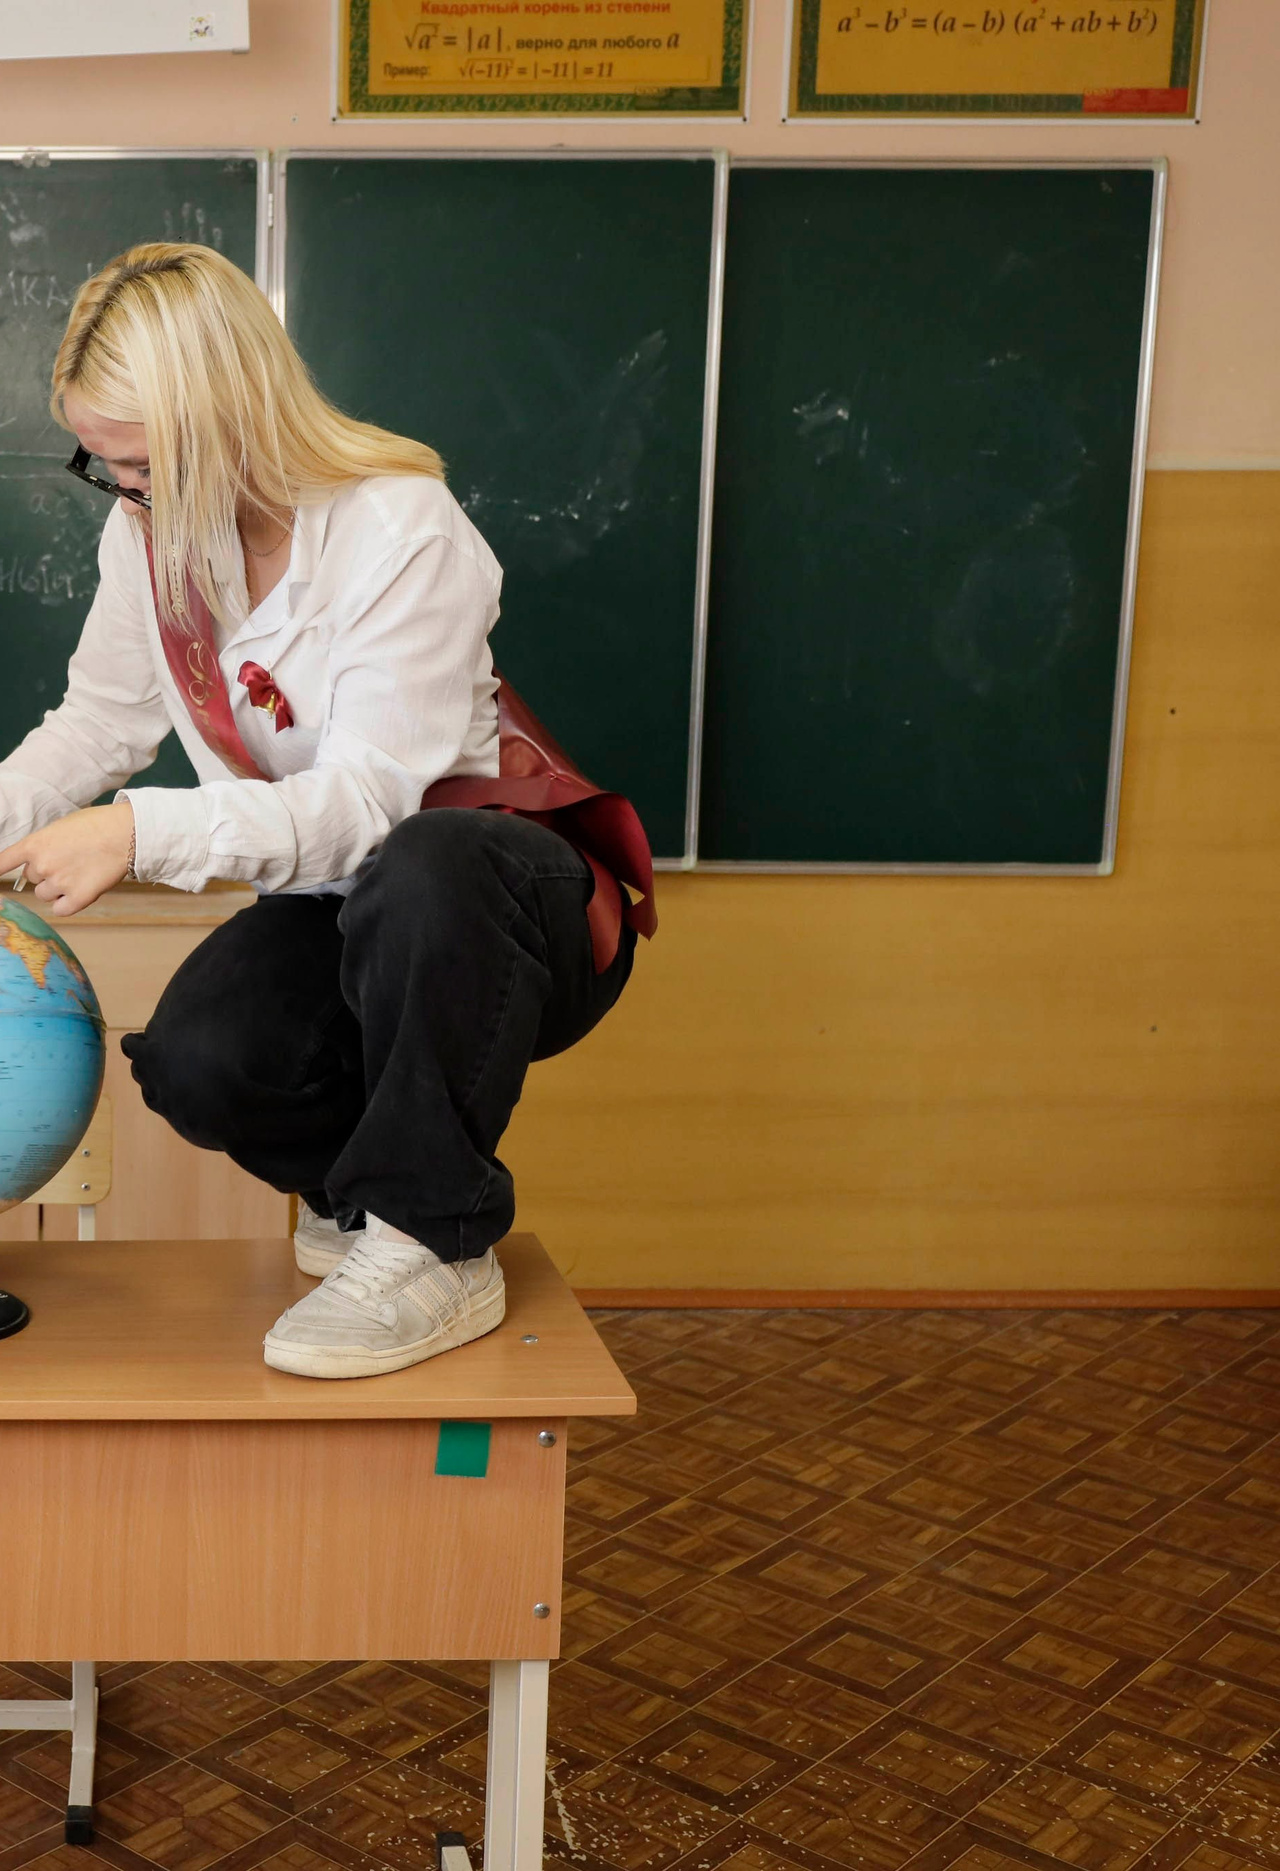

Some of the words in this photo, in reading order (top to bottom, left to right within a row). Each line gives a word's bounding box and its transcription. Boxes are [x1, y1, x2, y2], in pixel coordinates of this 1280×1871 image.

[421, 0, 526, 15] Квадратный
[529, 1, 581, 15] корень
[584, 2, 602, 14] из
[605, 1, 671, 14] степени
[516, 37, 563, 50] верно
[568, 37, 597, 52] для
[602, 35, 662, 50] любого
[666, 31, 680, 50] a
[383, 62, 432, 78] Пример:
